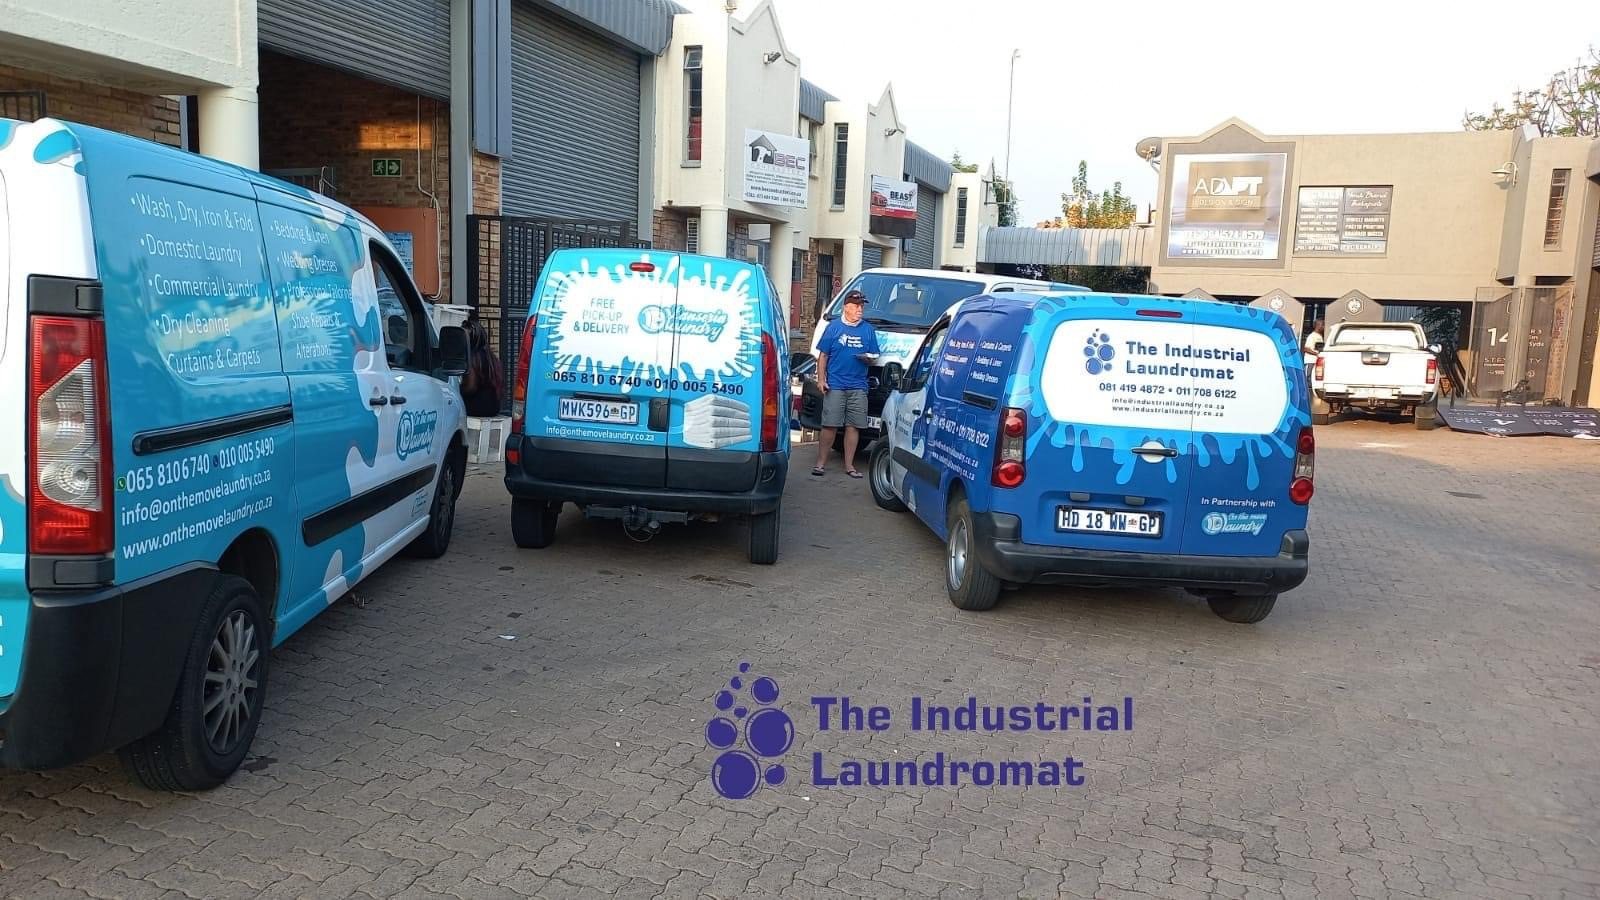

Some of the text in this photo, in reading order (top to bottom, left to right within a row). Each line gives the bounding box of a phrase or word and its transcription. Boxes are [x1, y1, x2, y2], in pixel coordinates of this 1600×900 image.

[775, 153, 805, 170] BEC
[890, 191, 912, 200] BEAST
[1193, 176, 1263, 196] ADAPT
[136, 192, 254, 232] Wash, Dry, Iron & Fold
[274, 220, 306, 245] Bedding
[145, 233, 241, 268] Domestic Laundry
[280, 250, 338, 274] Wedding Dresses
[155, 274, 258, 299] Commercial Laundry
[287, 282, 326, 299] Professional
[591, 298, 616, 309] FREE
[162, 312, 231, 339] Dry Cleaning
[292, 313, 310, 329] Shoe
[582, 309, 623, 322] PICK-UP
[573, 320, 630, 334] & DELIVERY
[168, 349, 261, 374] Curtains & Carpets
[1125, 341, 1250, 362] The Industrial
[1126, 360, 1234, 380] Laundromat
[553, 371, 744, 396] 065 810 6740 010 005 5490
[1099, 382, 1237, 399] 081 419 4872 011 708 6122
[620, 405, 636, 420] GP
[546, 425, 655, 442] info@onthemovelaundry.co.za
[976, 431, 990, 447] 6122
[126, 466, 154, 493] 065
[219, 446, 237, 469] 010
[238, 442, 254, 464] 005
[255, 436, 275, 460] 5490
[121, 469, 271, 526] info@onthemovelaundry.co.za
[1201, 497, 1209, 505] In
[1212, 498, 1258, 508] Partnership
[122, 496, 273, 559] www.onthemovelaundry.co.za
[1062, 511, 1079, 527] HD
[1086, 512, 1103, 528] 18
[1140, 516, 1156, 532] GP
